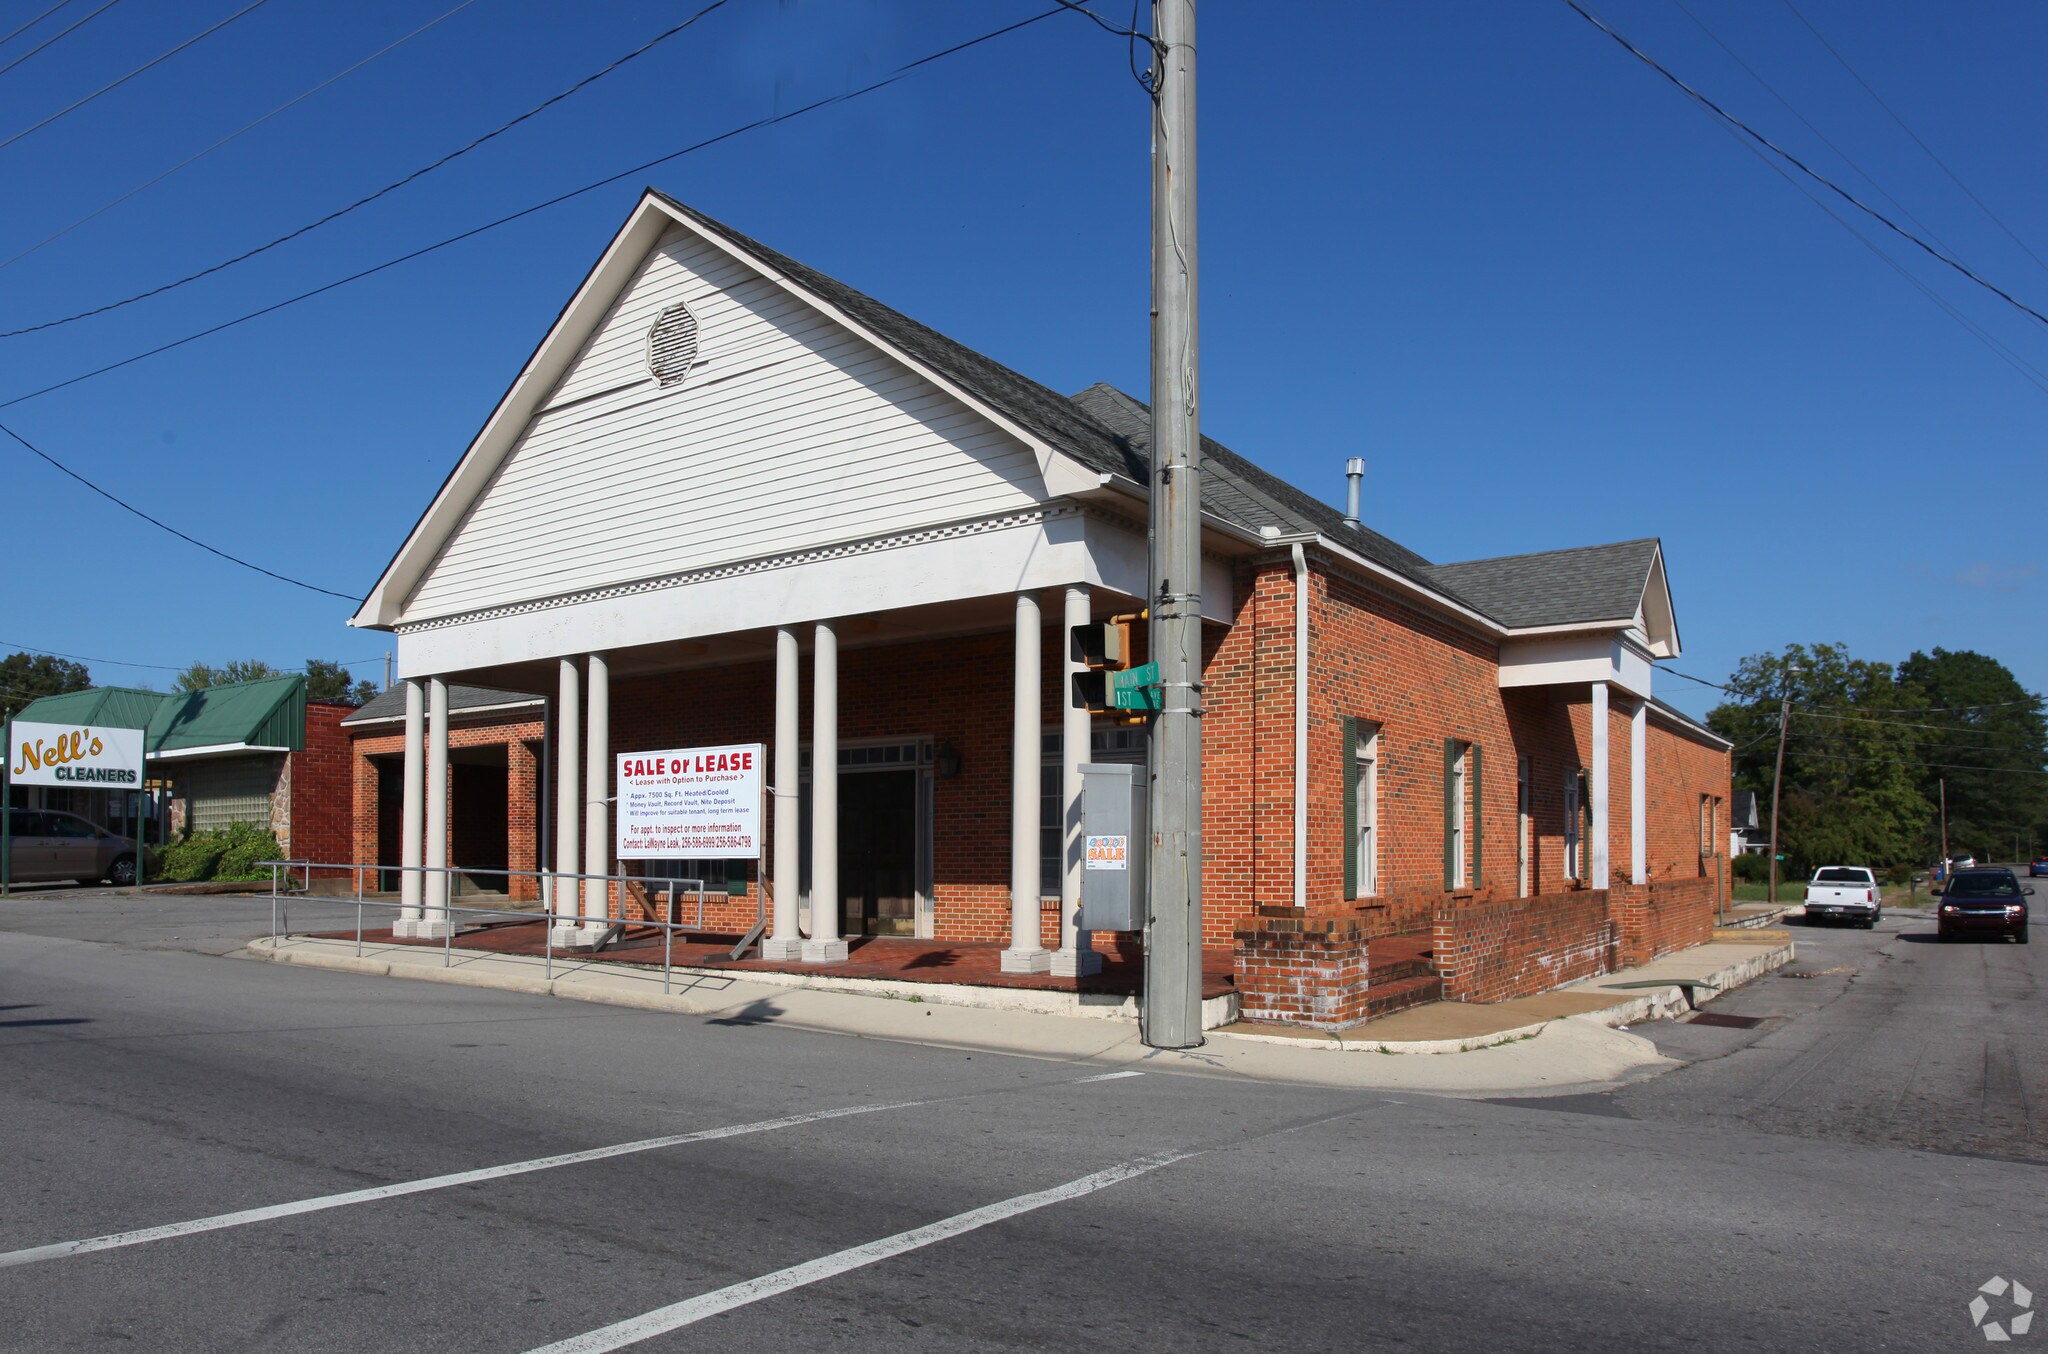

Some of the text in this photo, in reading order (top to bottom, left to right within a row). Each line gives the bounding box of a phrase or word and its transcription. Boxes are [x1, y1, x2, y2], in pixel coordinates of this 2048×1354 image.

[1118, 666, 1155, 688] MAIN ST
[1117, 691, 1131, 706] 1ST
[14, 728, 103, 775] Nell's
[624, 752, 752, 777] SALE or LEASE
[55, 766, 137, 783] CLEANERS
[635, 773, 738, 786] Lease with Option to Purchase
[664, 791, 673, 799] Sq.
[713, 797, 736, 806] Deposit
[640, 809, 659, 817] improve
[630, 822, 742, 836] For appt. to inspect or more information
[1088, 847, 1125, 861] SALE
